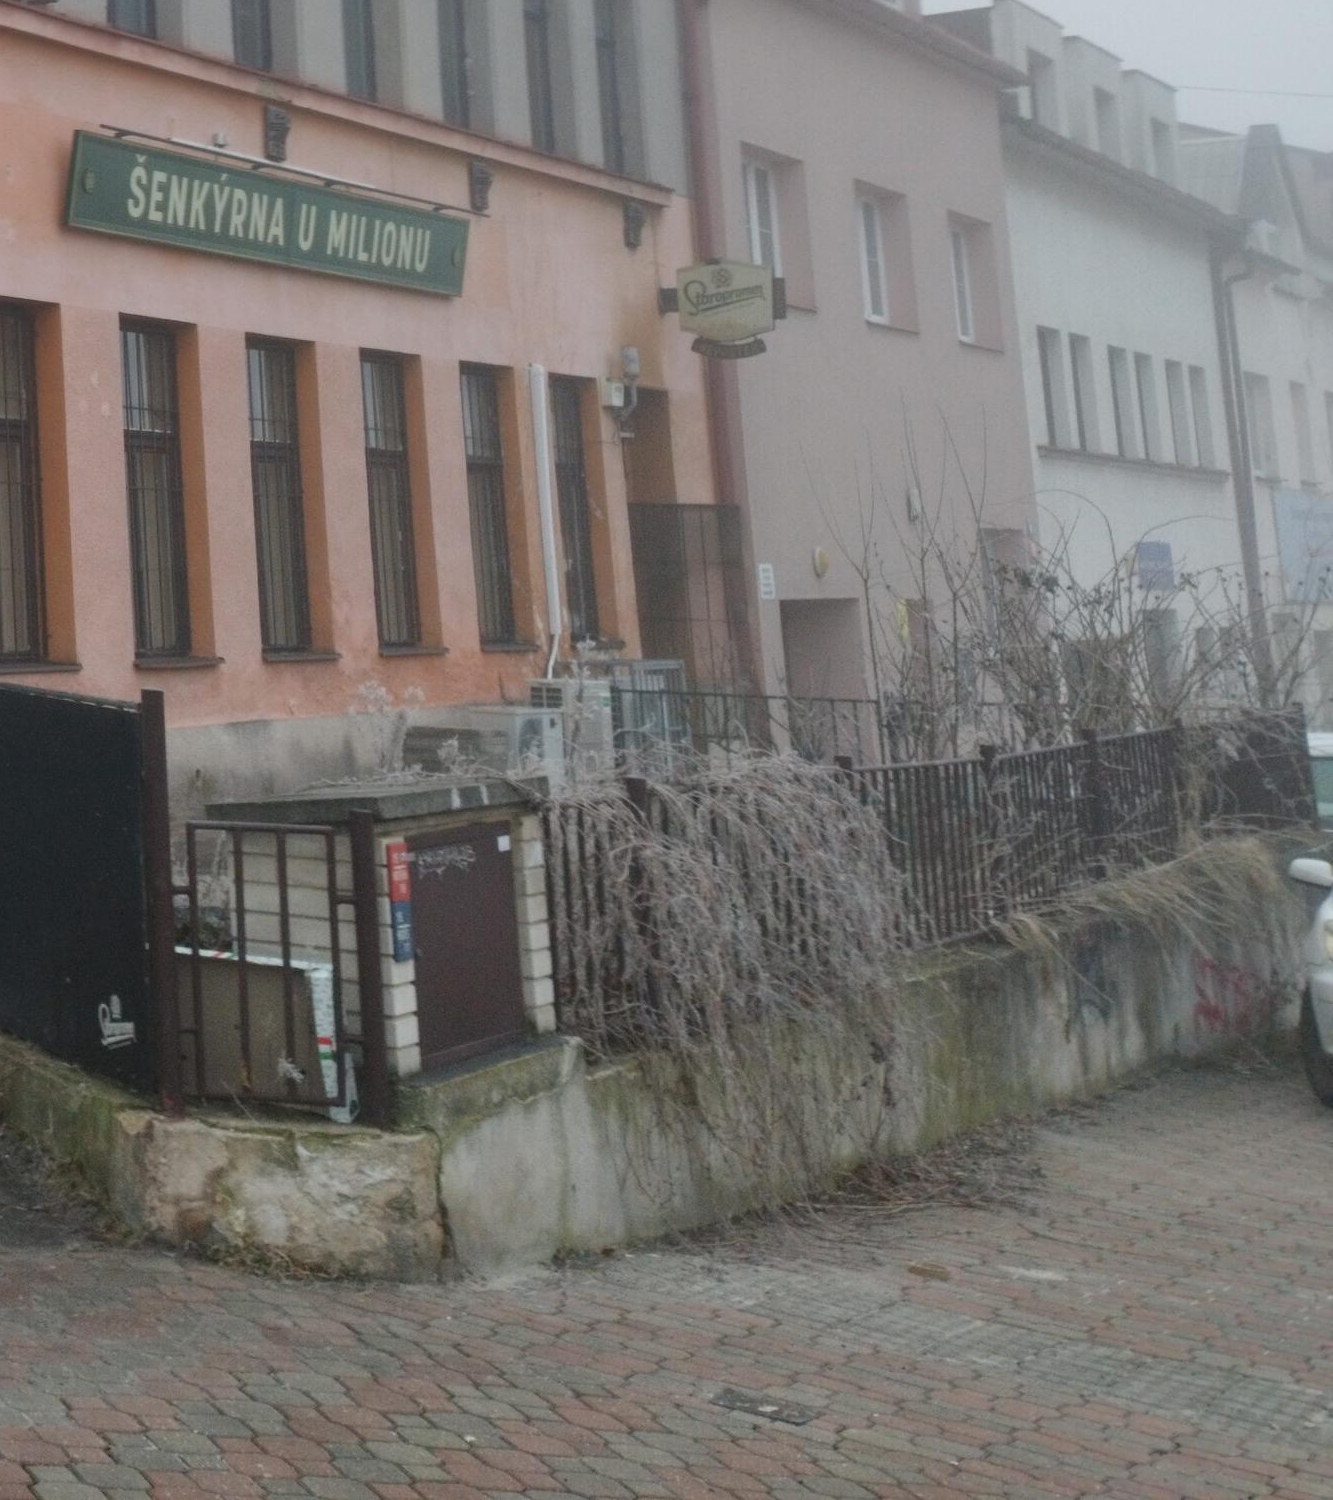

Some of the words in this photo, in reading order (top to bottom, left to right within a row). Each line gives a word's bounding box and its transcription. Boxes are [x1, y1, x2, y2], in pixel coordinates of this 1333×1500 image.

[126, 154, 285, 246] ŠENKÝRNA
[298, 203, 316, 252] U
[327, 209, 432, 273] MILIONU
